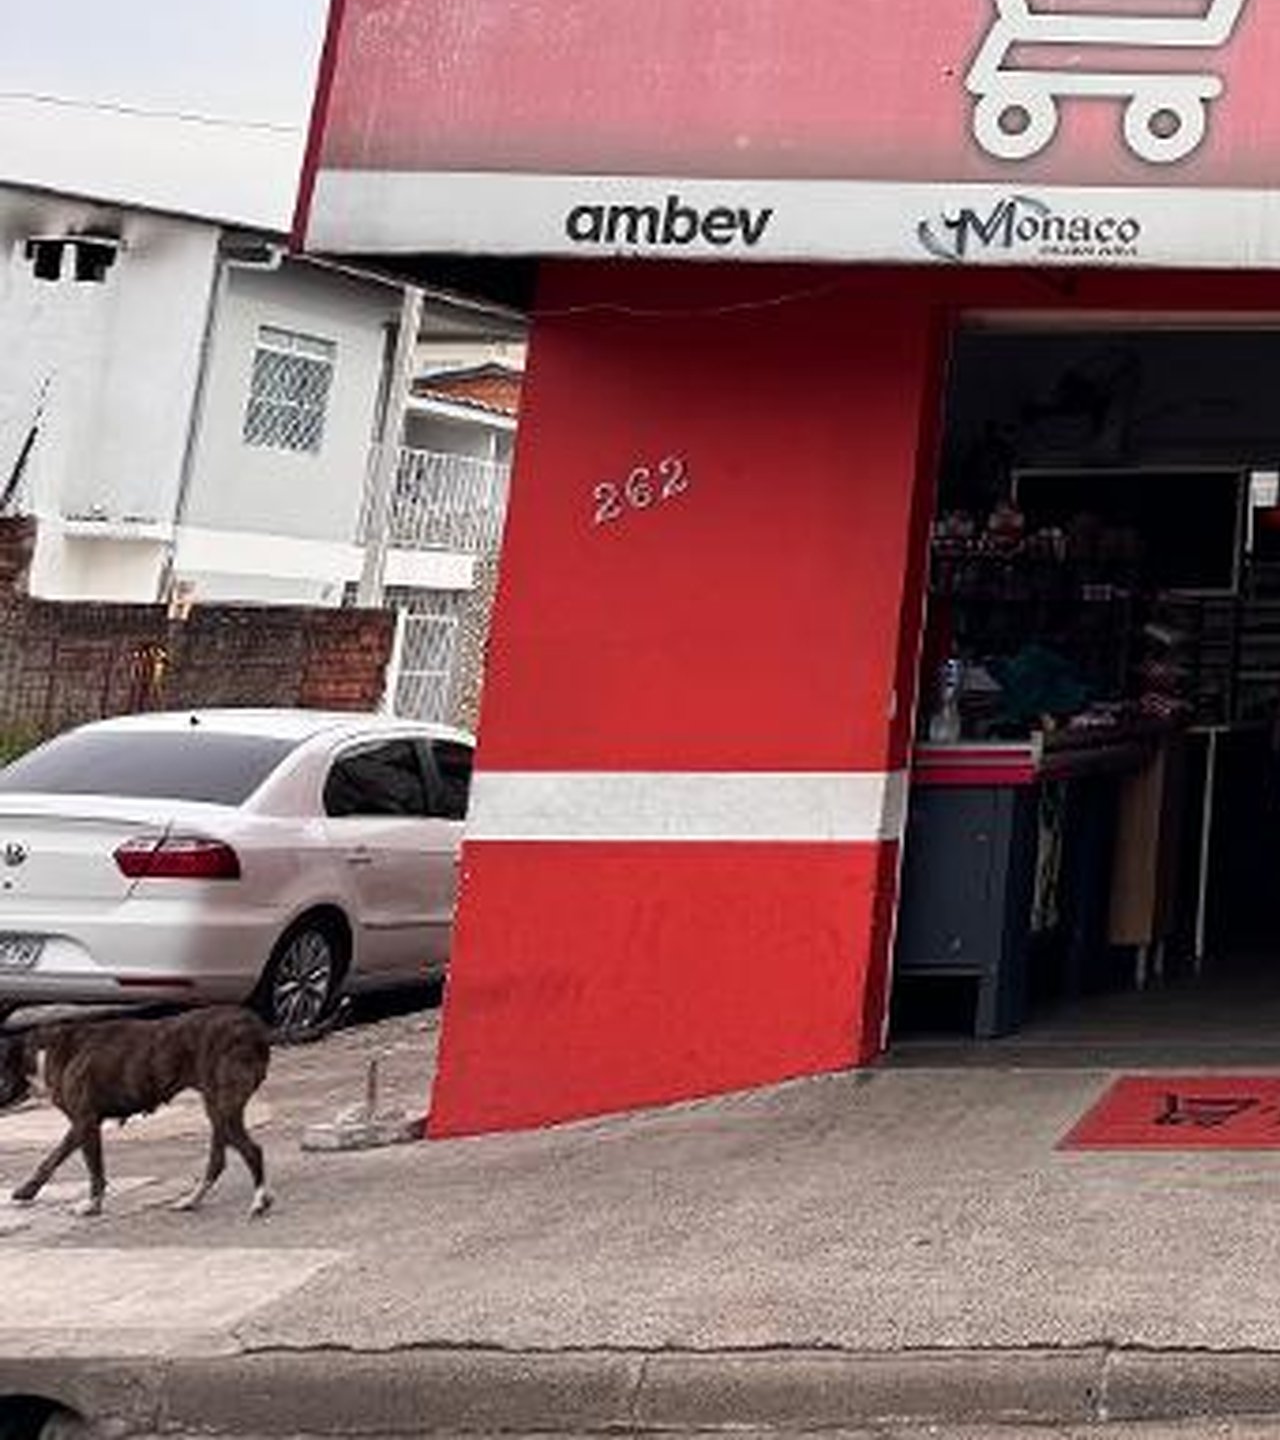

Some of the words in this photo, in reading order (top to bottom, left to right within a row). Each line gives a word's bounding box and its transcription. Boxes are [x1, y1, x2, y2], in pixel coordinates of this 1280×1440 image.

[565, 193, 775, 248] ambev
[940, 196, 1142, 257] Monaco
[592, 455, 689, 526] 262
